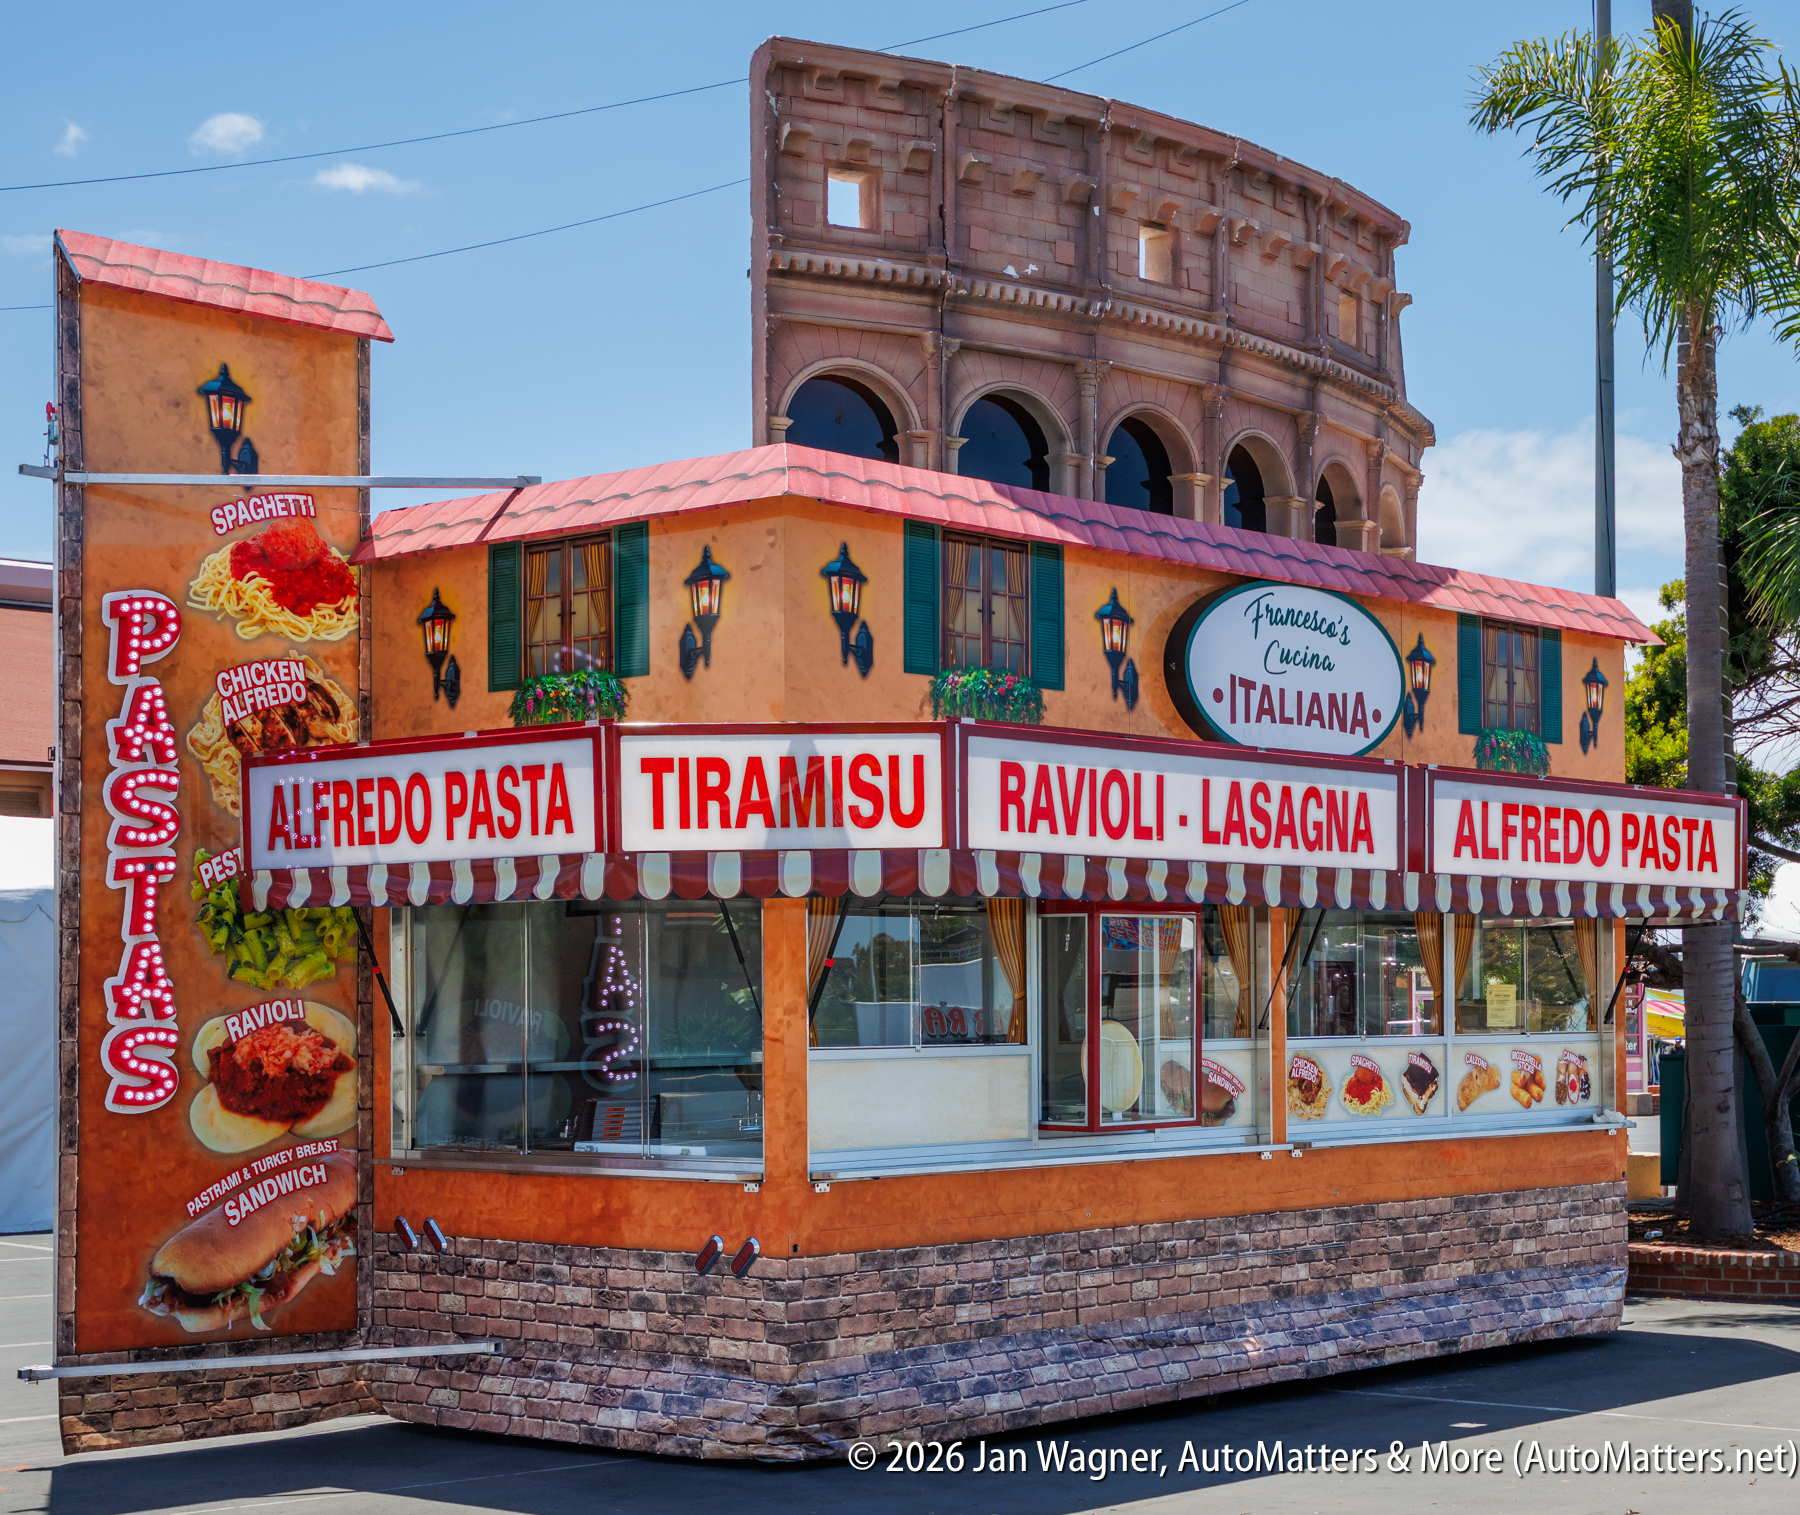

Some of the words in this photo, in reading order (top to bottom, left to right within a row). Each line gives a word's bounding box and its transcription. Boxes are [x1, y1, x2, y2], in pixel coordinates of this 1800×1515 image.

[212, 494, 316, 535] SPAGHETTI
[1244, 592, 1350, 646] Francesco's
[217, 661, 306, 697] CHICKEN
[1264, 640, 1335, 675] Cucina
[221, 682, 307, 727] ALFREDO
[1230, 673, 1370, 739] ITALIANA
[268, 772, 432, 851] ALFREDO
[445, 762, 574, 841] PASTA
[640, 753, 925, 830] TIRAMISU
[1000, 761, 1165, 841] RAVIOLI
[1202, 778, 1375, 854] LASAGNA
[107, 596, 181, 1107] PASTAS
[1453, 799, 1610, 868] ALFREDO
[1621, 813, 1718, 873] PASTA
[226, 999, 304, 1043] RAVIOLI
[1291, 1067, 1317, 1083] ALFREDO
[1293, 1057, 1319, 1076] CHICKEN
[1351, 1055, 1380, 1074] SPAGHETTI
[1408, 1053, 1432, 1073] TIRAMISU
[1465, 1054, 1488, 1070] CALZONE
[1517, 1060, 1535, 1074] STICKS
[1208, 1071, 1239, 1099] SANDWICH
[187, 1170, 242, 1217] PASTRAMI
[242, 1167, 252, 1181] &
[251, 1149, 293, 1175] TURKEY
[296, 1140, 339, 1159] BREAST
[224, 1164, 328, 1226] SANDWICH
